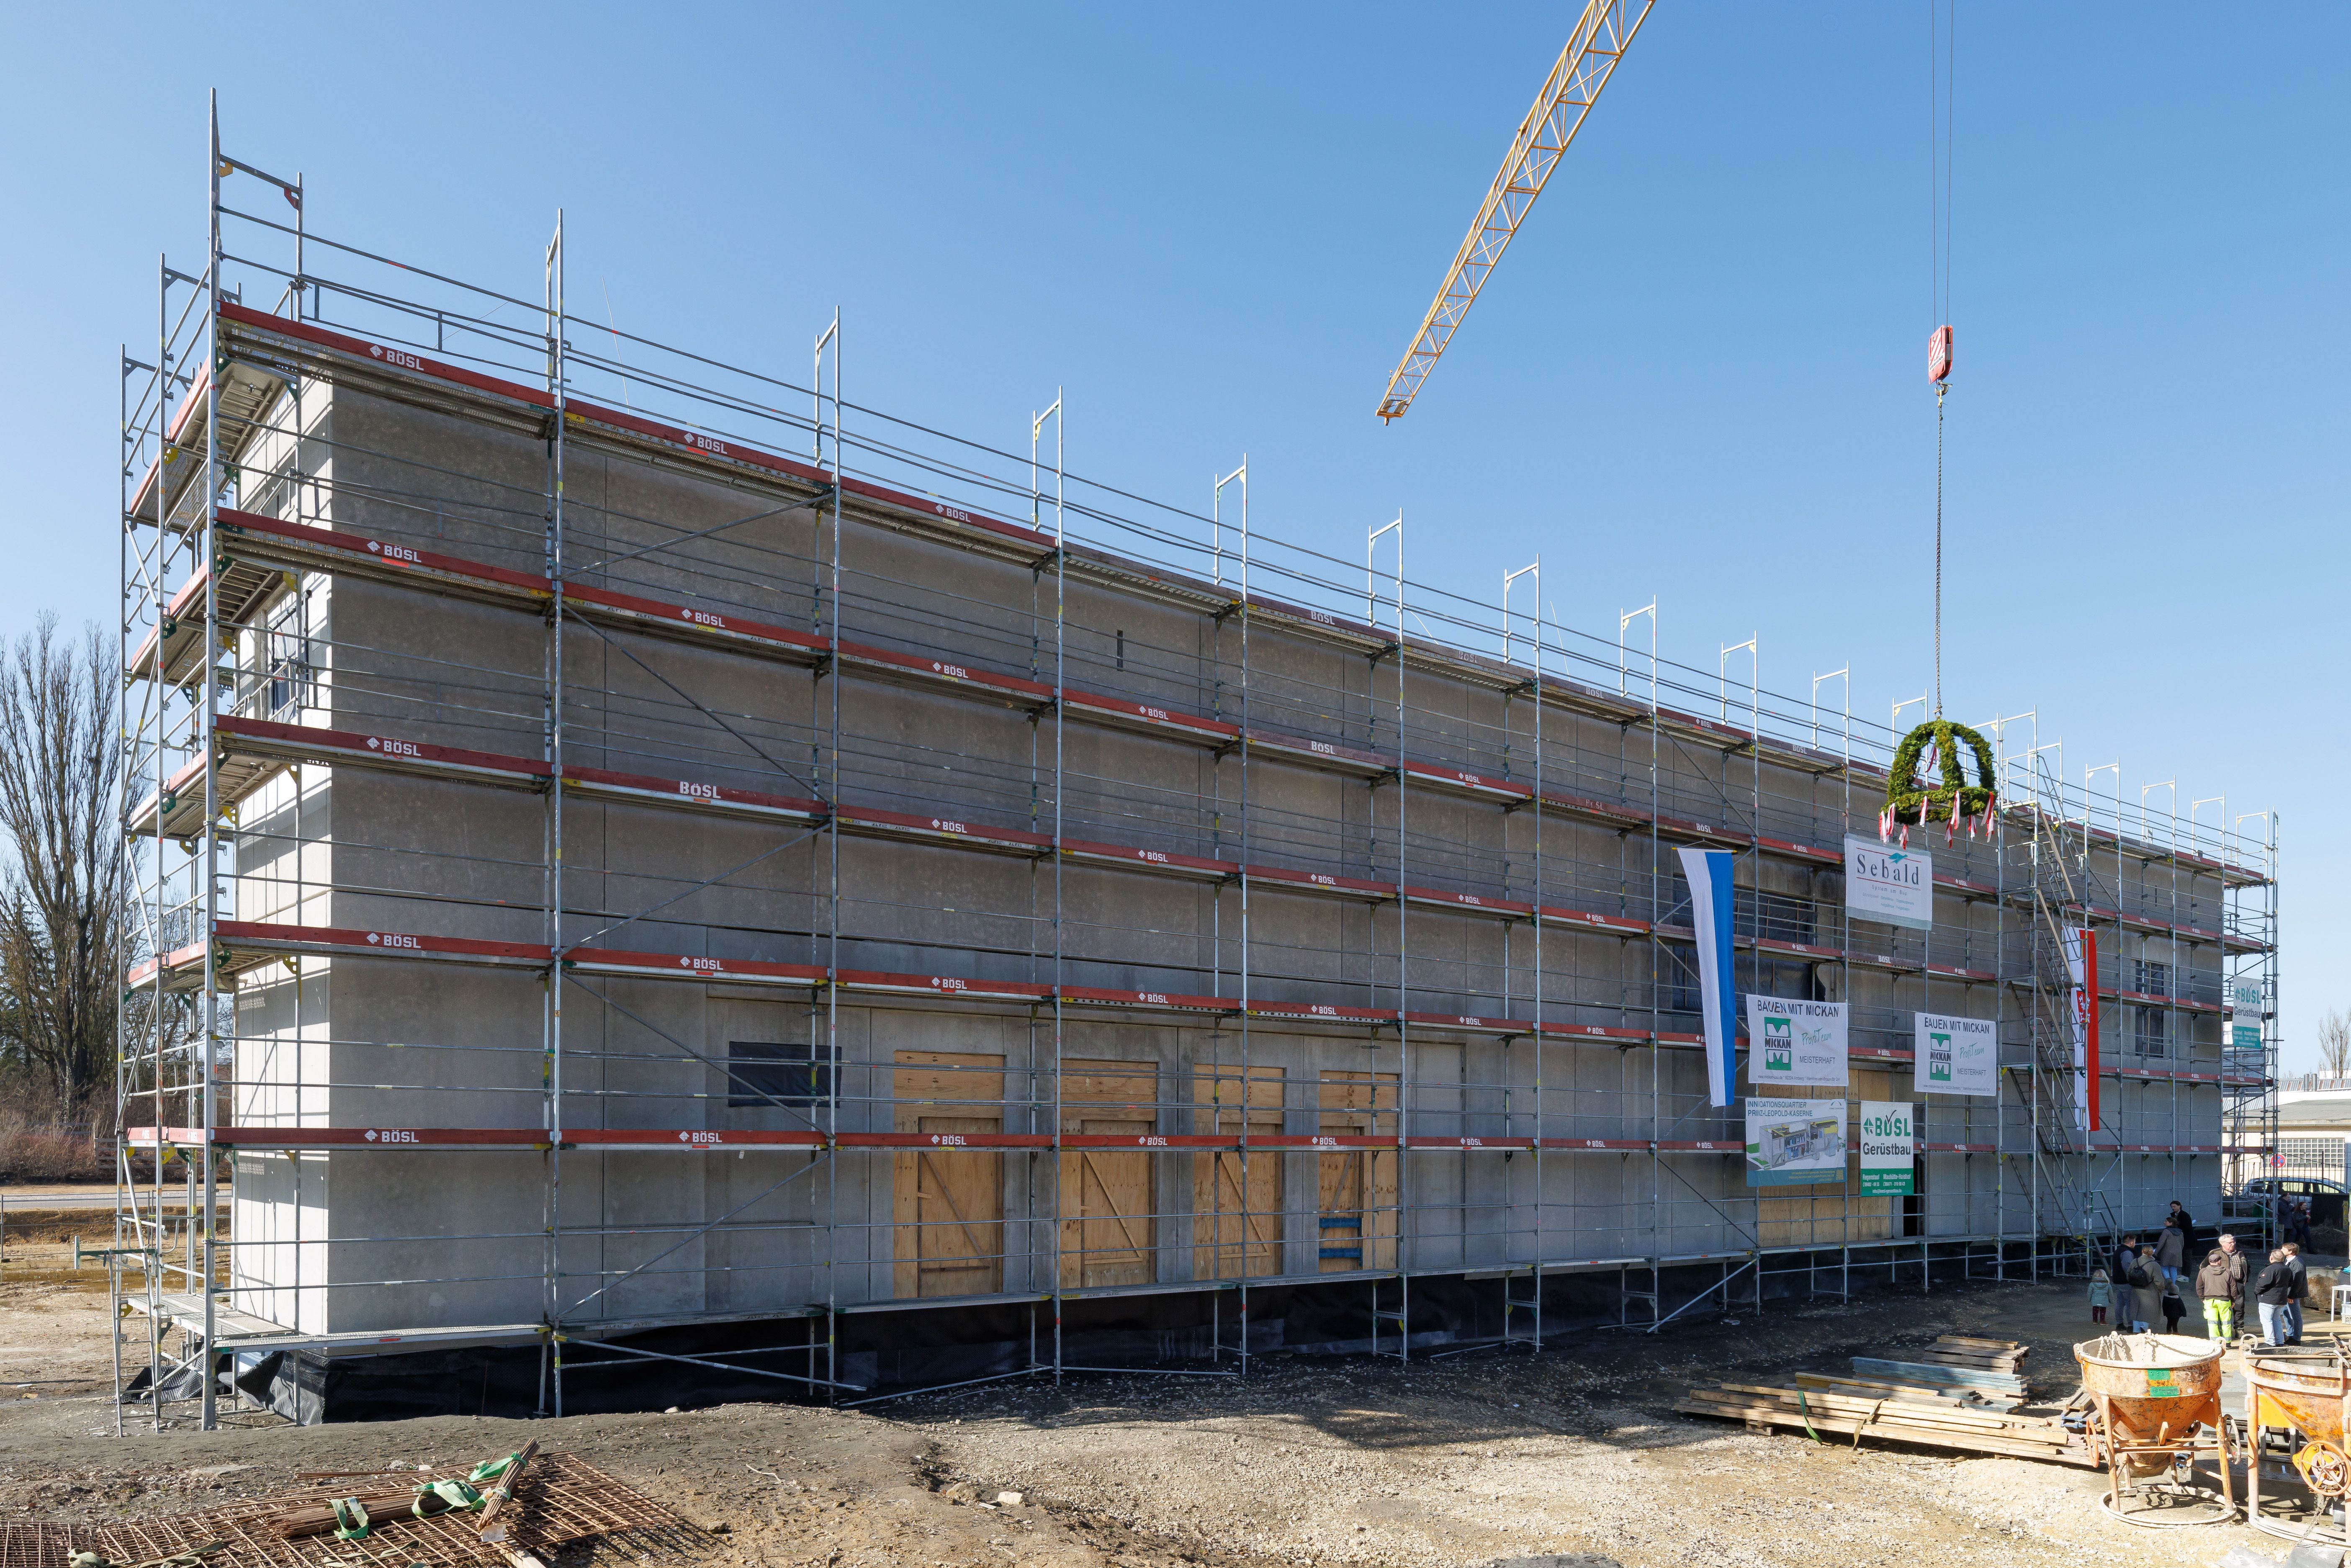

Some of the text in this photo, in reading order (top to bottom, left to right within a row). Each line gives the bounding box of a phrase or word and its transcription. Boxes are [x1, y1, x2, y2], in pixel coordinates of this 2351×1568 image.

[387, 350, 424, 370] BÖSL
[697, 437, 727, 455] BÖSL
[947, 508, 970, 522] BÖSL
[385, 545, 421, 563] BÖSL
[695, 612, 725, 627] BÖSL
[944, 665, 968, 678] BÖSL
[1148, 708, 1168, 720] BÖSL
[1701, 720, 1712, 728] BÖSL
[384, 740, 421, 756] BÖSL
[1465, 774, 1480, 783] BÖSL
[680, 781, 720, 798] BÖSL
[943, 821, 967, 833] BÖSL
[1147, 851, 1168, 862] BÖSL
[1857, 853, 1919, 885] Sebald
[1319, 874, 1335, 884] BÖSL
[1465, 895, 1480, 904] BÖSL
[383, 934, 421, 949] BÖSL
[694, 958, 723, 970] BÖSL
[943, 978, 967, 989] BÖSL
[1148, 993, 1168, 1003] BÖSL
[1319, 1005, 1336, 1015] BÖSL
[1758, 1000, 1839, 1018] BAUEN MIT MICKAN
[2234, 1006, 2260, 1018] Gerüstbau
[1466, 1017, 1481, 1025] BÖSL
[1950, 1020, 1961, 1031] MIT
[1963, 1022, 1989, 1034] MICKAN
[1765, 1037, 1791, 1049] MICKAN
[1800, 1056, 1836, 1064] MEISTERHAFT
[1930, 1051, 1951, 1062] MICKAN
[382, 1130, 419, 1142] BÖSL
[693, 1131, 722, 1143] BÖSL
[942, 1135, 966, 1144] BÖSL
[1147, 1136, 1167, 1145] BÖSL
[1320, 1136, 1337, 1145] BÖSL
[1467, 1137, 1482, 1145] BÖSL
[1863, 1142, 1911, 1155] Gerüstbau
